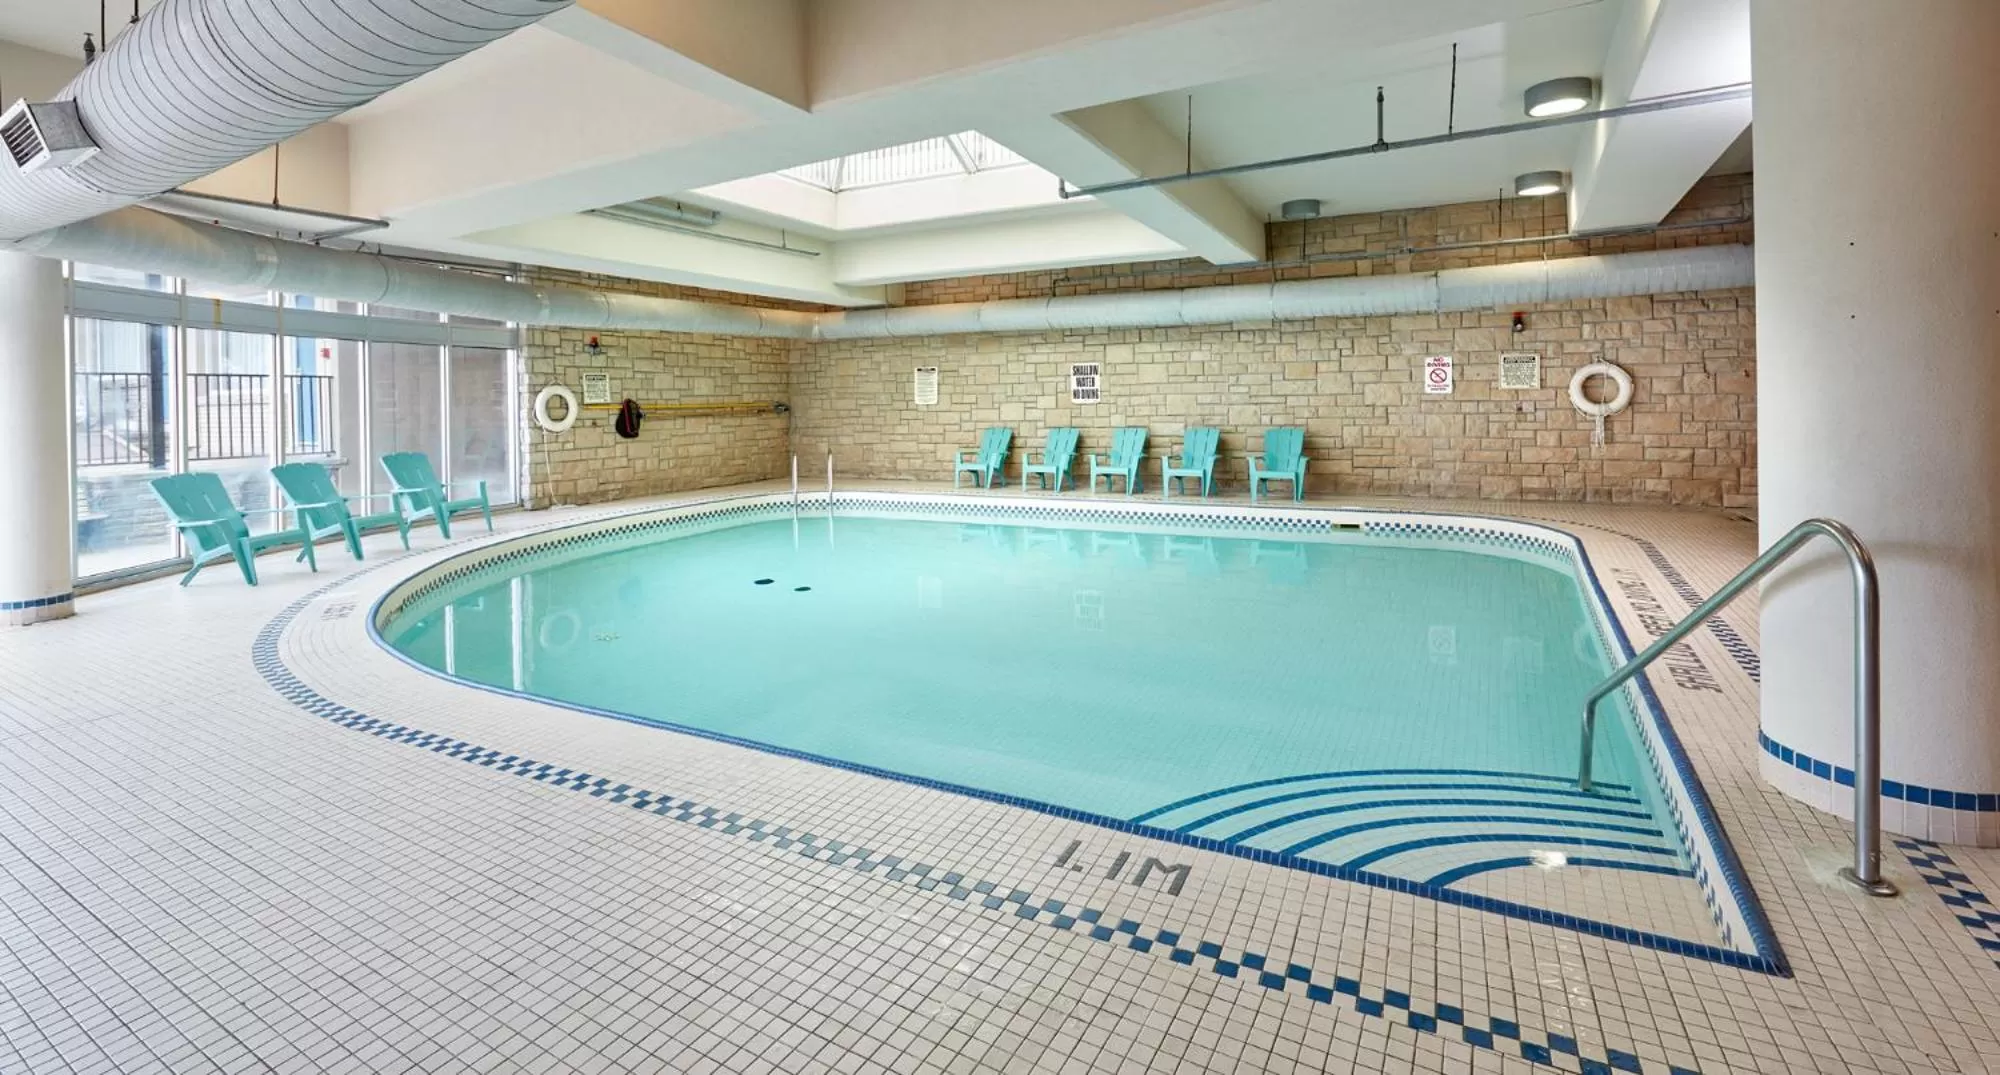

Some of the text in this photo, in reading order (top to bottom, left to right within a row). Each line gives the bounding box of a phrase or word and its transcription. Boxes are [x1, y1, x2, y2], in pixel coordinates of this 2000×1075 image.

[1072, 365, 1098, 376] SHALLOW
[1076, 377, 1095, 387] WATER
[1073, 388, 1099, 399] NO DIVING
